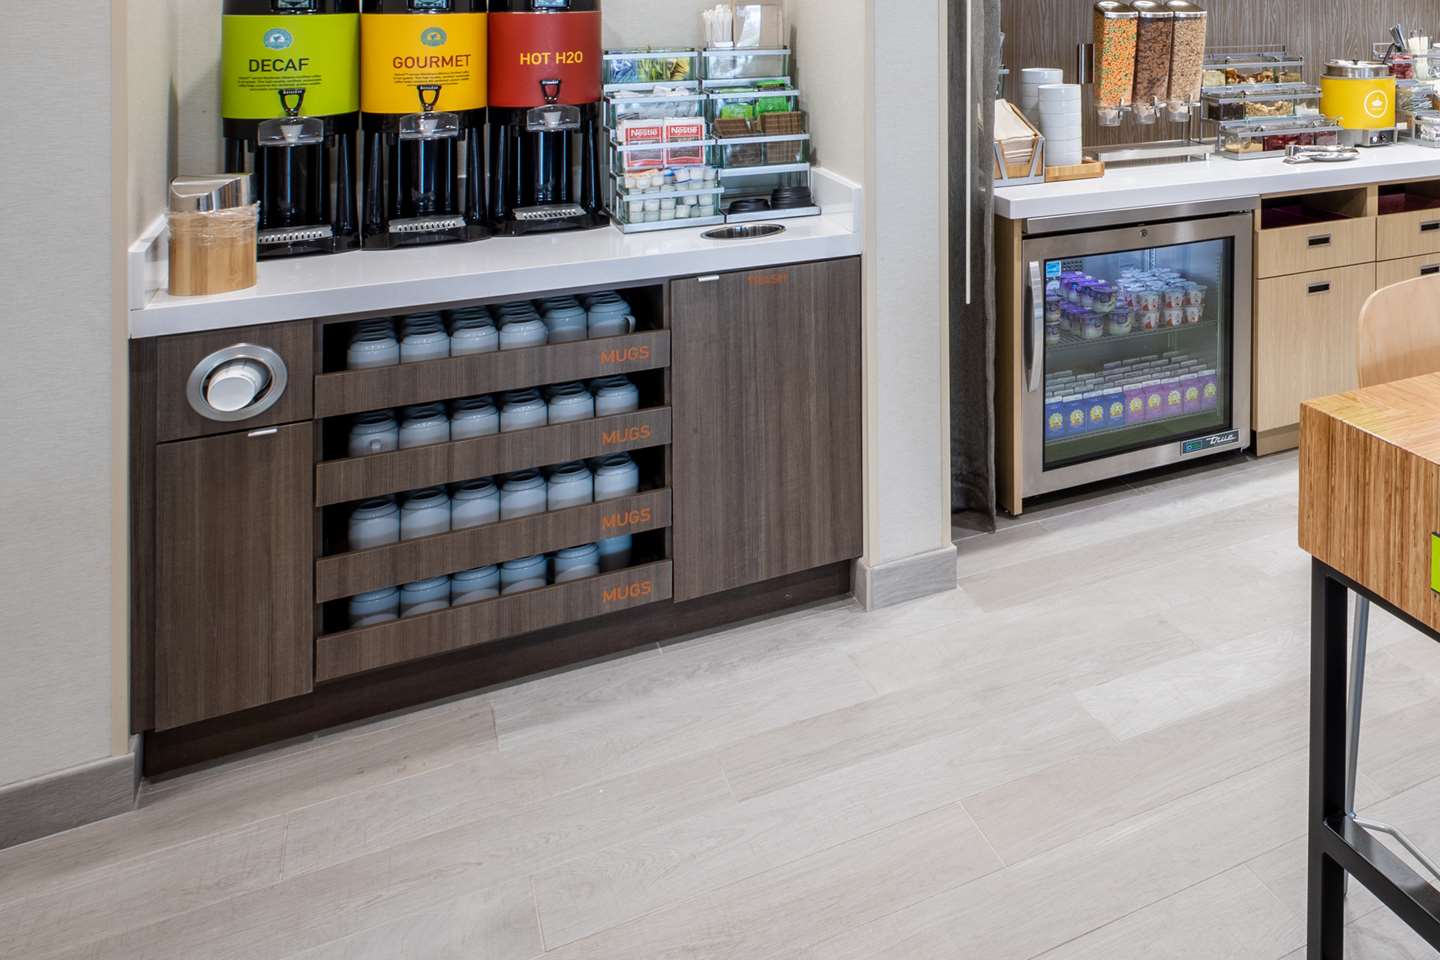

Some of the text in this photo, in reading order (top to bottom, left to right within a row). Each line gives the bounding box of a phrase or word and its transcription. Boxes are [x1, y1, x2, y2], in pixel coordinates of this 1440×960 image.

[248, 58, 309, 72] DECAF
[392, 54, 471, 69] GOURMET
[520, 52, 551, 65] HOT
[600, 345, 650, 364] MUGS
[601, 425, 652, 445] MUGS
[602, 507, 652, 529] MUGS
[602, 580, 652, 602] MUGS
